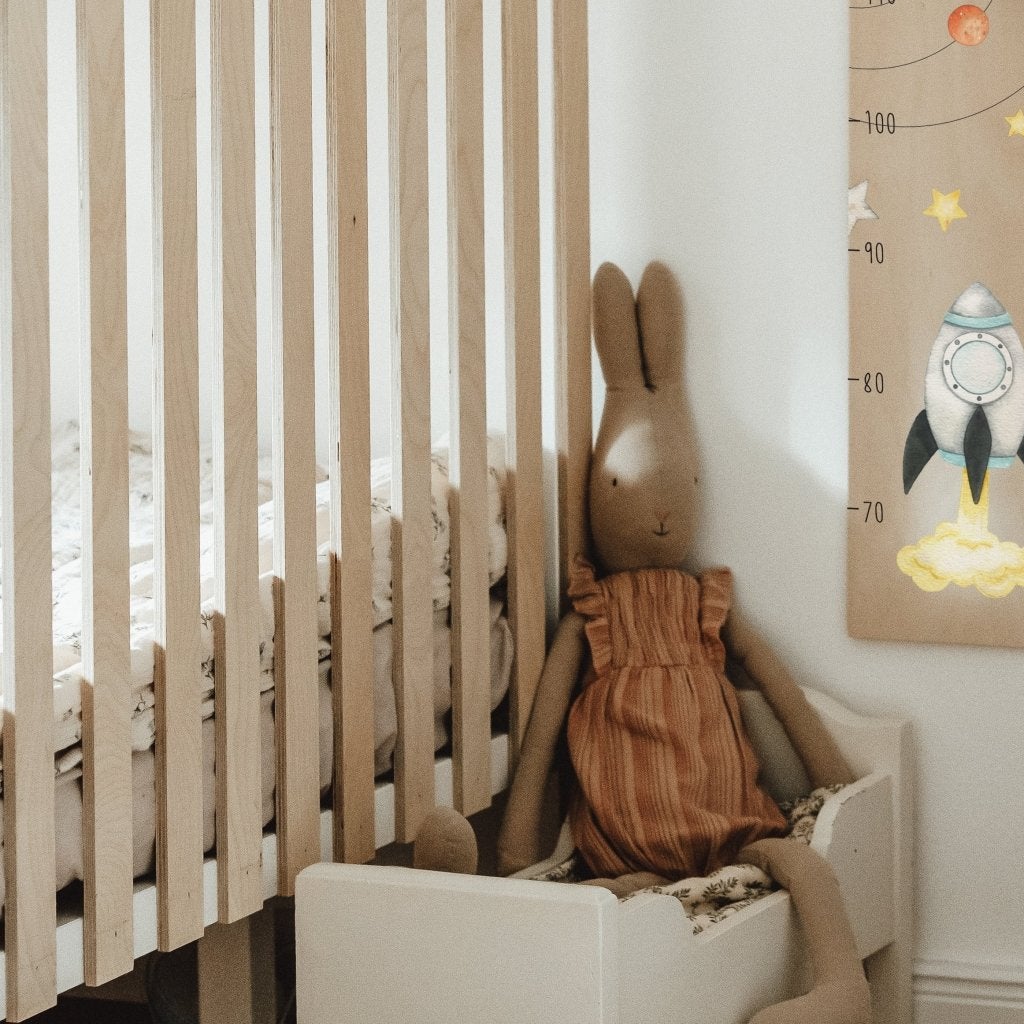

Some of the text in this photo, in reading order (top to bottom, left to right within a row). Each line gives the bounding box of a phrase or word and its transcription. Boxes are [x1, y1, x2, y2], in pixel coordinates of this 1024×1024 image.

[865, 110, 897, 135] 100
[864, 241, 885, 265] 90
[863, 371, 885, 395] 80
[862, 500, 884, 524] 70
